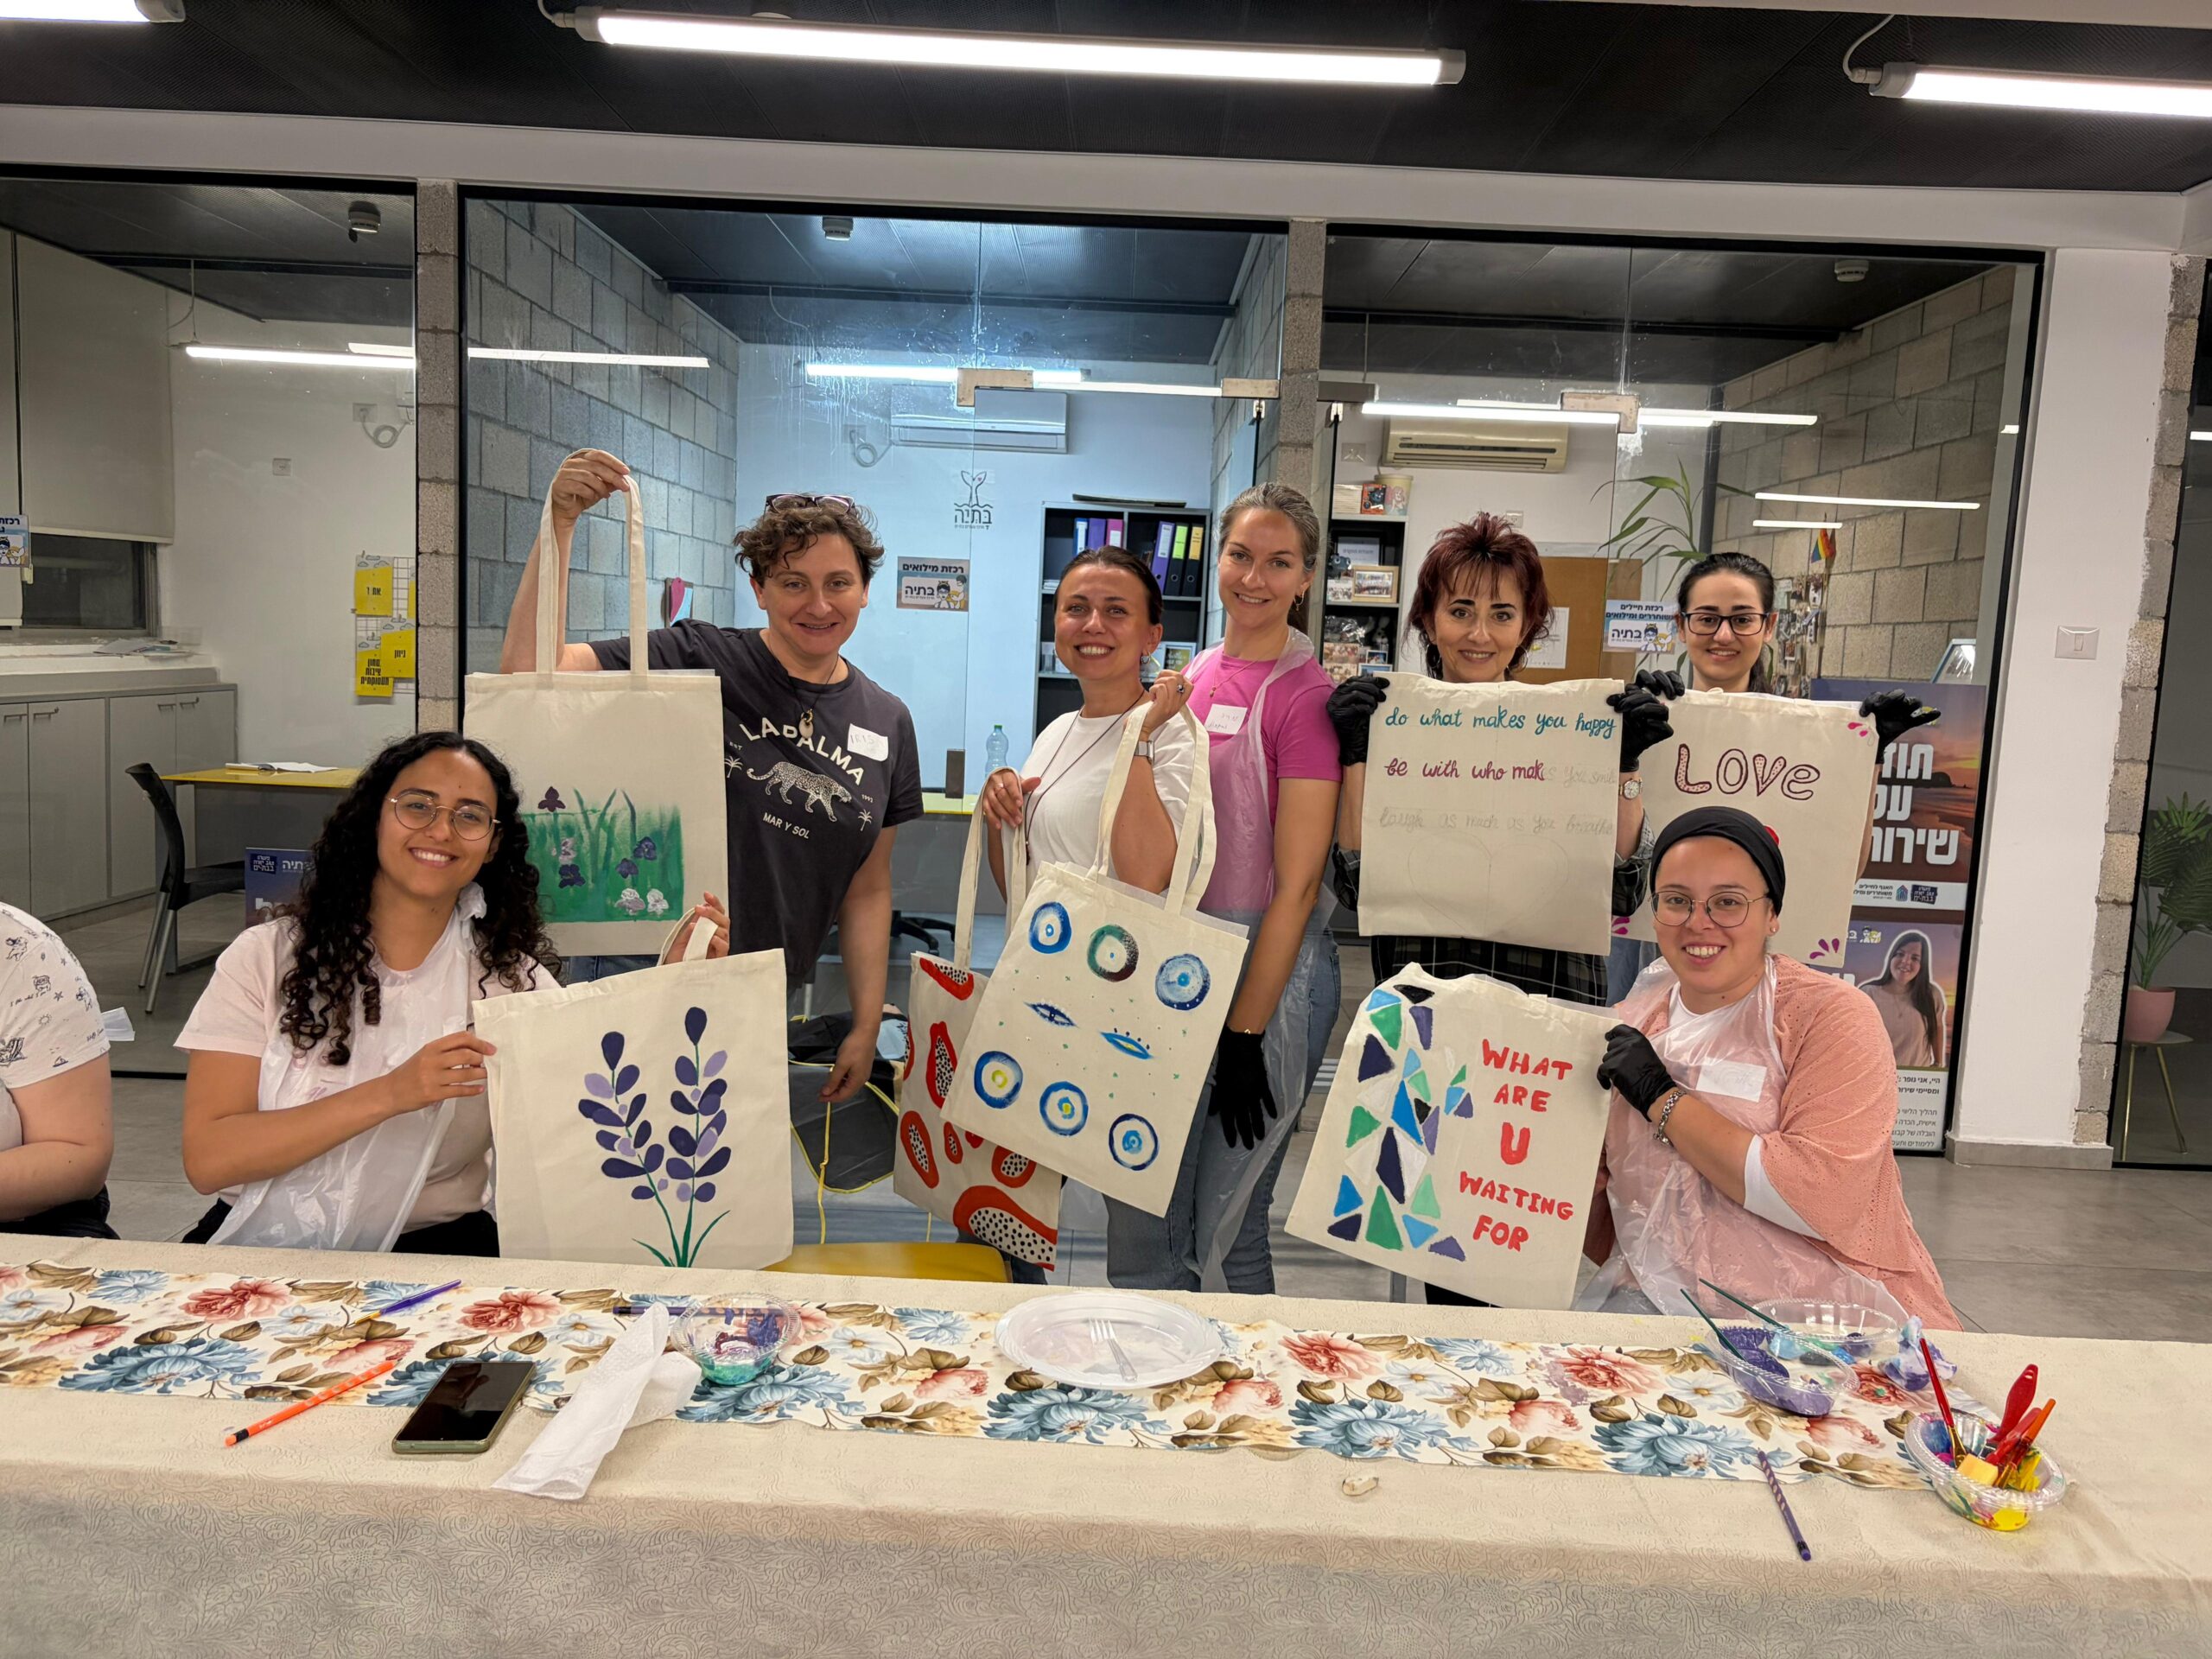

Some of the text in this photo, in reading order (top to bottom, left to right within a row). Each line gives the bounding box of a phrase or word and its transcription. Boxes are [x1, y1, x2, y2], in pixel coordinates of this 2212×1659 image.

[902, 563, 964, 574] רכזת מילואים
[1385, 705, 1617, 739] do what makes you happy
[1384, 757, 1408, 777] be
[1422, 760, 1460, 779] with
[1471, 760, 1507, 781] who
[763, 811, 810, 839] MAR Y SOL
[283, 860, 303, 870] תיה
[1482, 1039, 1573, 1080] WHAT
[1493, 1083, 1552, 1113] ARE
[1500, 1122, 1531, 1165] U
[1459, 1171, 1573, 1221] WAITING
[1472, 1214, 1529, 1252] FOR
